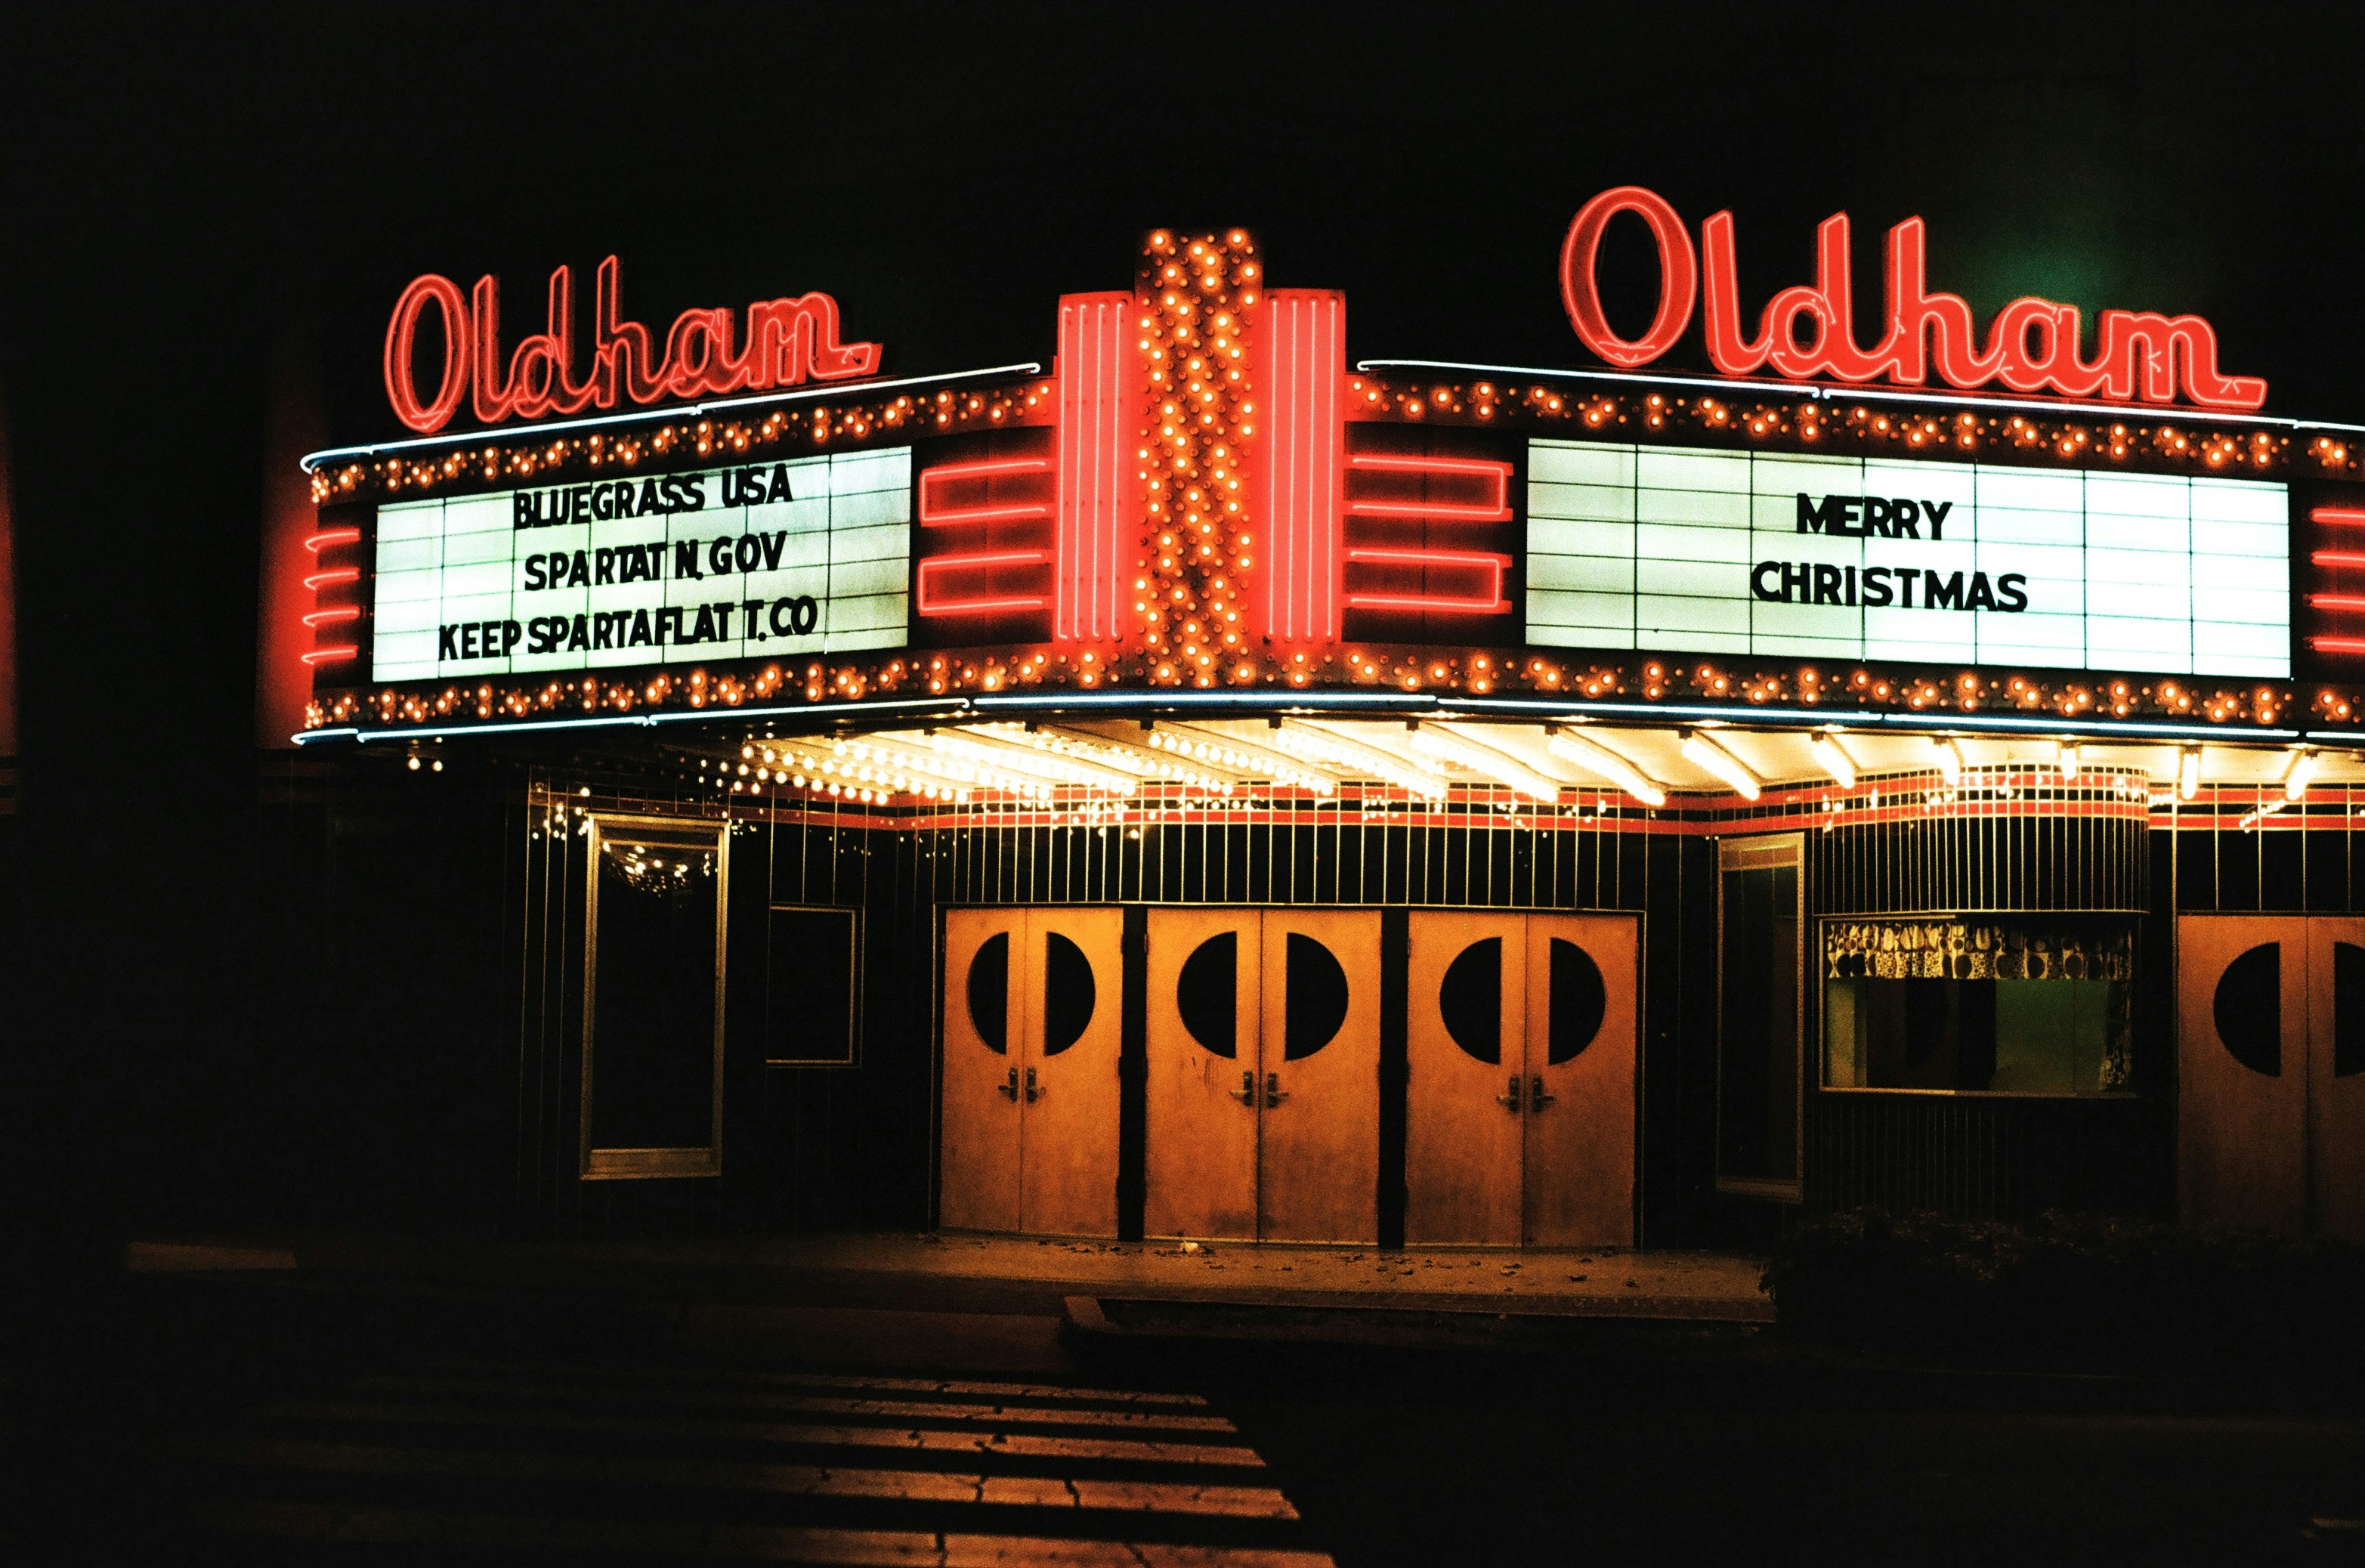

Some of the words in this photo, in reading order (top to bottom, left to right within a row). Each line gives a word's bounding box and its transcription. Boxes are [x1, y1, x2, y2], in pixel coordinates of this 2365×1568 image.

[1559, 185, 2267, 408] Oldham
[384, 255, 883, 433] Oldham
[514, 474, 706, 530] BLUEGRASS
[722, 463, 793, 507] USA
[1797, 493, 1953, 540] MERRY
[1751, 561, 2028, 612] CHRISTMAS
[439, 620, 521, 660] KEEP
